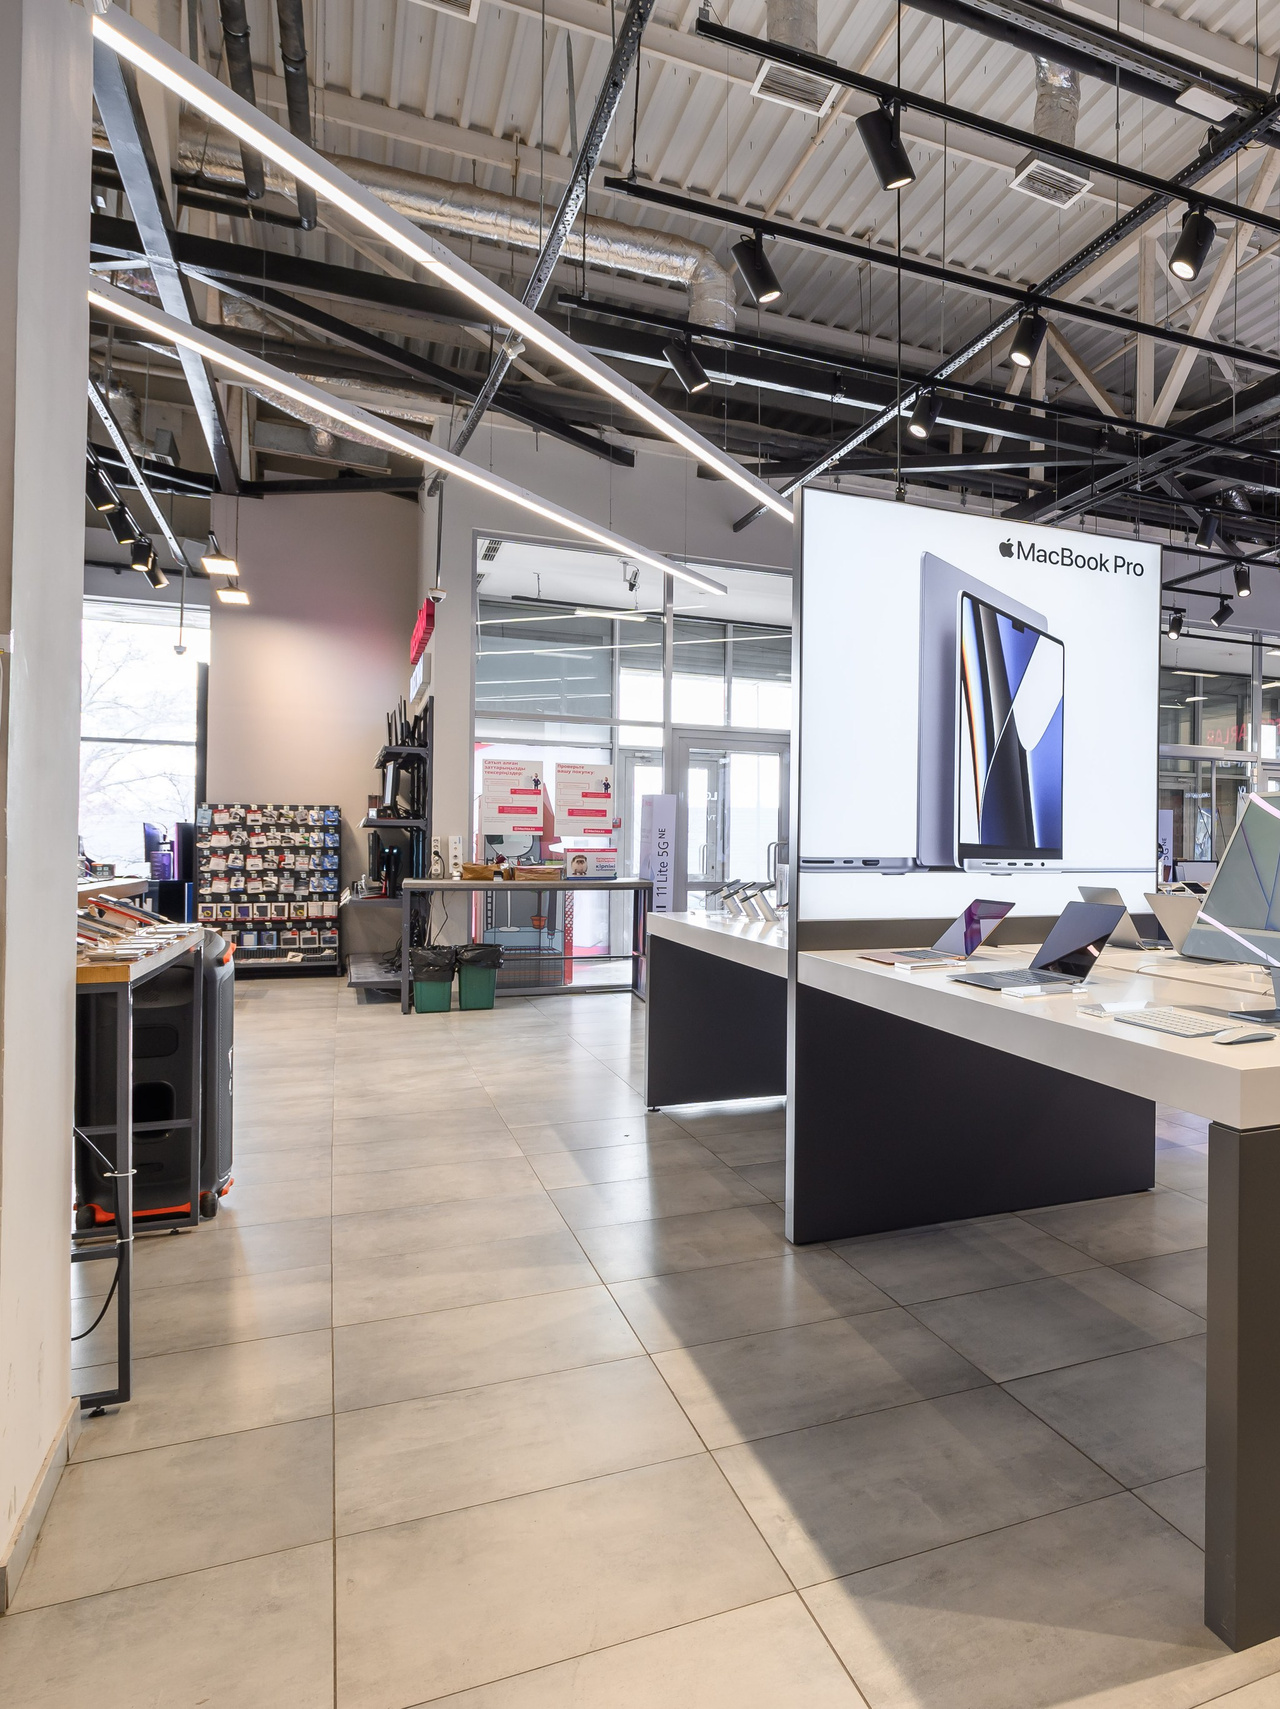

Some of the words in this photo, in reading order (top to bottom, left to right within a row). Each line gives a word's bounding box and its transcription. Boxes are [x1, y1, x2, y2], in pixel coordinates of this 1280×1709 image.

[1017, 540, 1109, 573] MacBook
[1114, 555, 1144, 577] Pro
[658, 828, 666, 839] NE
[657, 841, 669, 857] 5G
[656, 861, 669, 883] Lite
[656, 888, 668, 897] 11
